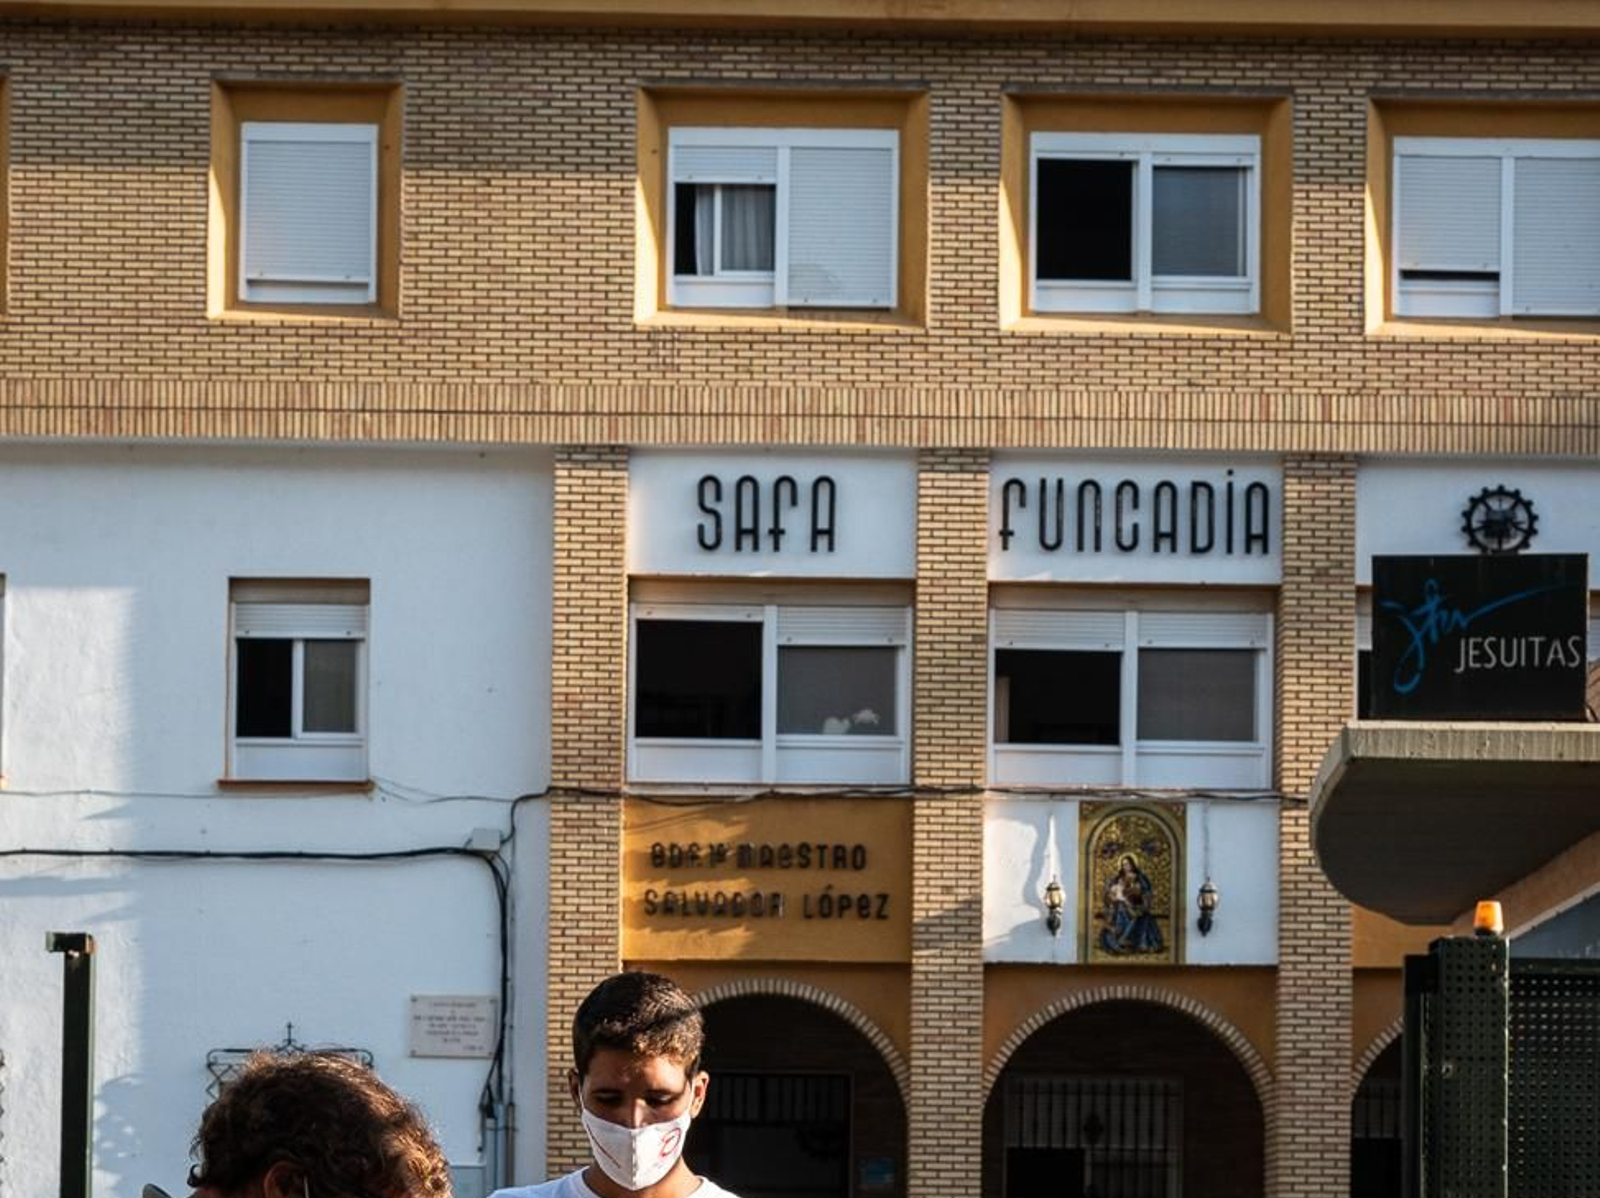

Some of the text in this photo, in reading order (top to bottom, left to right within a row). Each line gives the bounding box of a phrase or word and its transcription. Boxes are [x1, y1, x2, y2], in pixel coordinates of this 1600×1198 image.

[696, 475, 837, 554] SAFA
[1453, 635, 1583, 675] JESUITAS
[802, 884, 890, 919] LÓPEZ
